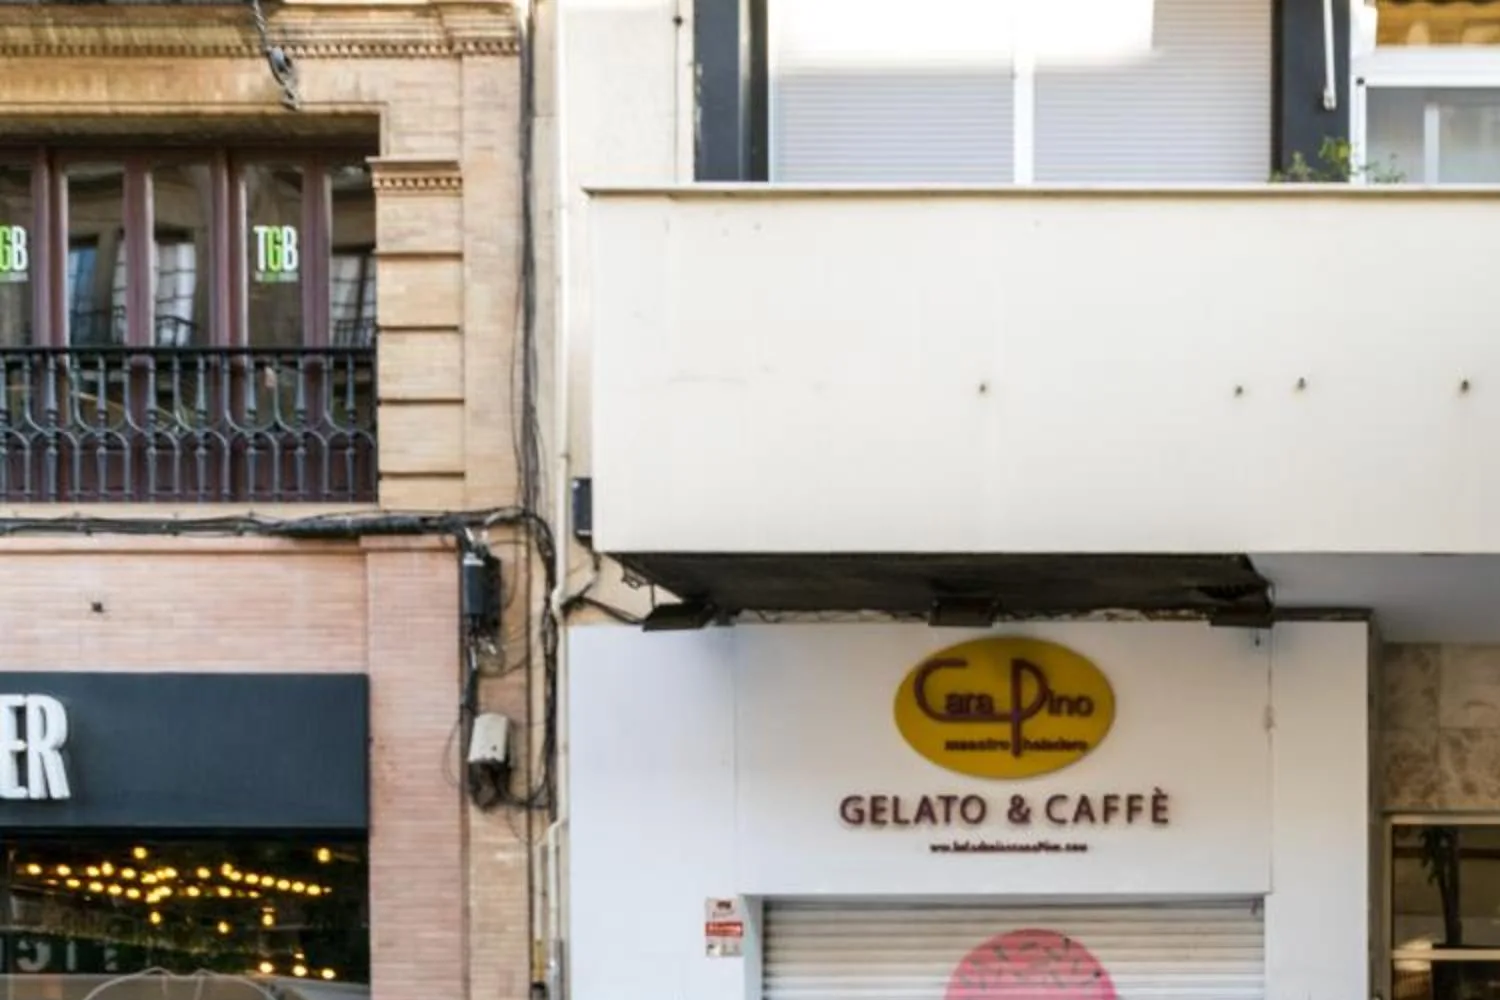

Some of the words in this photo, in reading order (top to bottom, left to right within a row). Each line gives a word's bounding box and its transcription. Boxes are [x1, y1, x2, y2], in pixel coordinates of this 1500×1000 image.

[253, 225, 299, 272] TGB
[840, 794, 987, 825] GELATO
[1007, 794, 1032, 825] &
[1045, 786, 1170, 825] CAFFÈ
